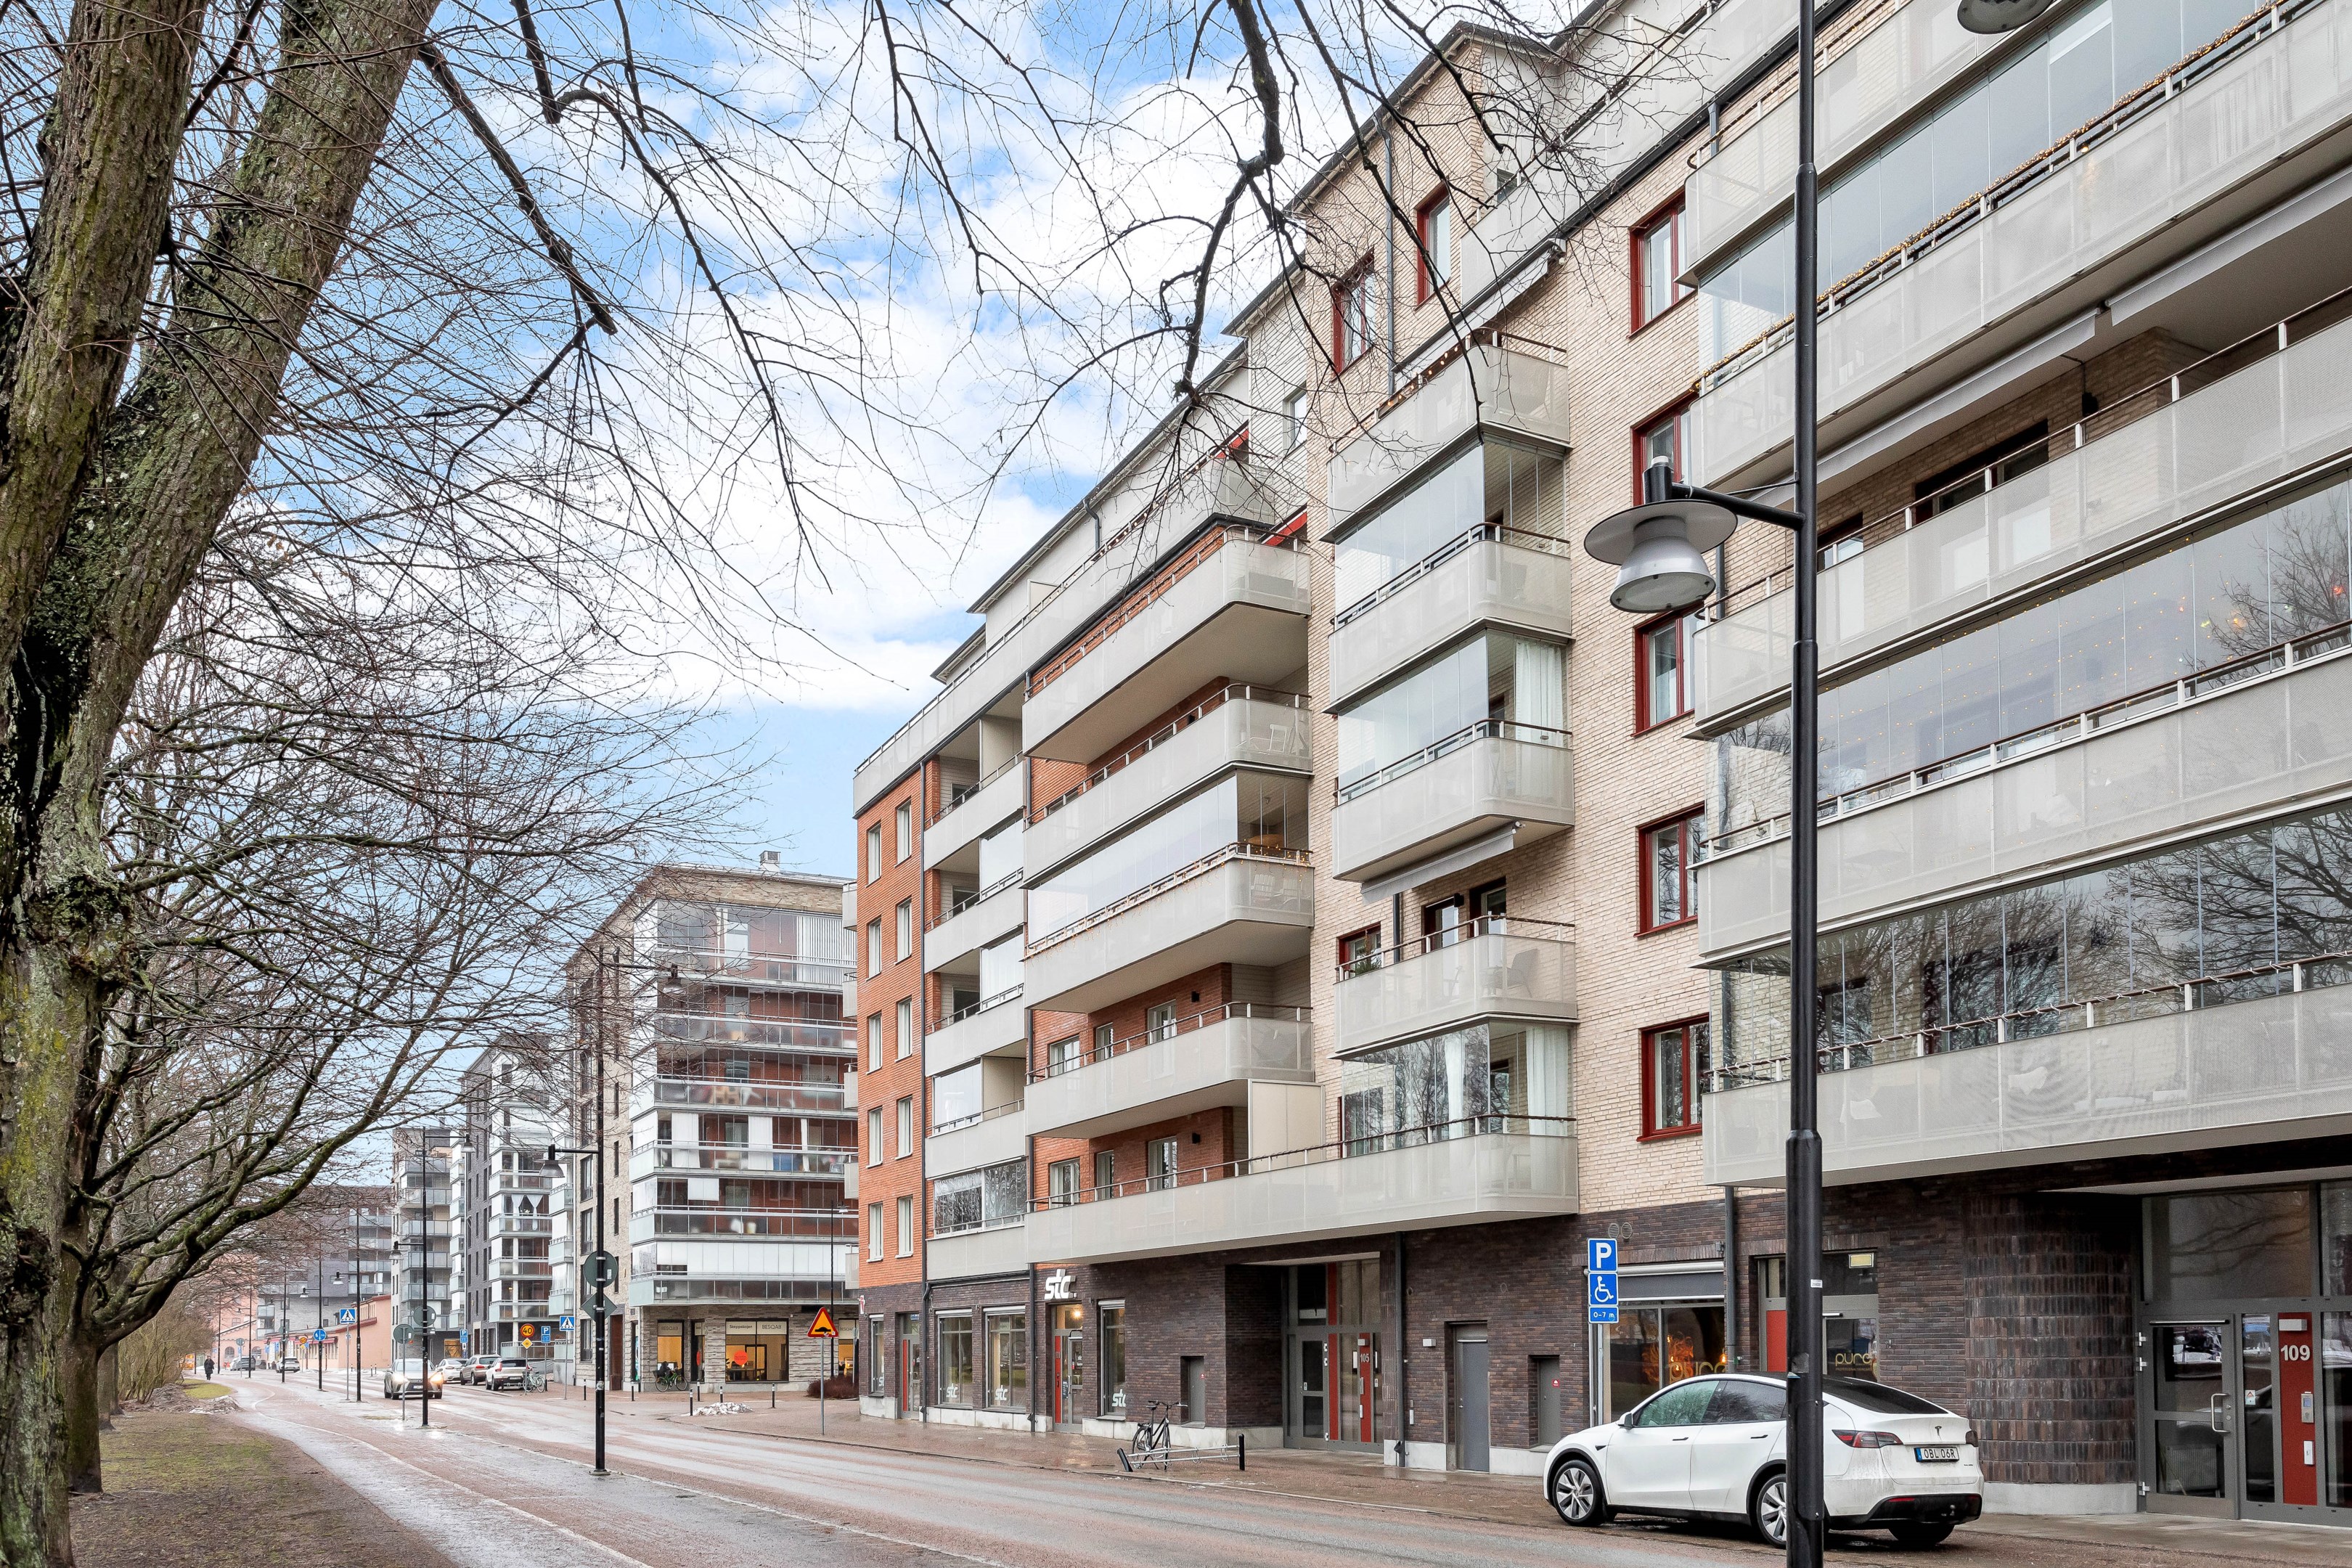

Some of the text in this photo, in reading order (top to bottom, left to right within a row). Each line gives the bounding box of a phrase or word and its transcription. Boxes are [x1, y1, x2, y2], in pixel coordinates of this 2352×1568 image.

[1596, 1242, 1612, 1268] P
[1360, 1353, 1370, 1363] 105
[2281, 1344, 2311, 1361] 109
[1924, 1448, 1939, 1458] OBL
